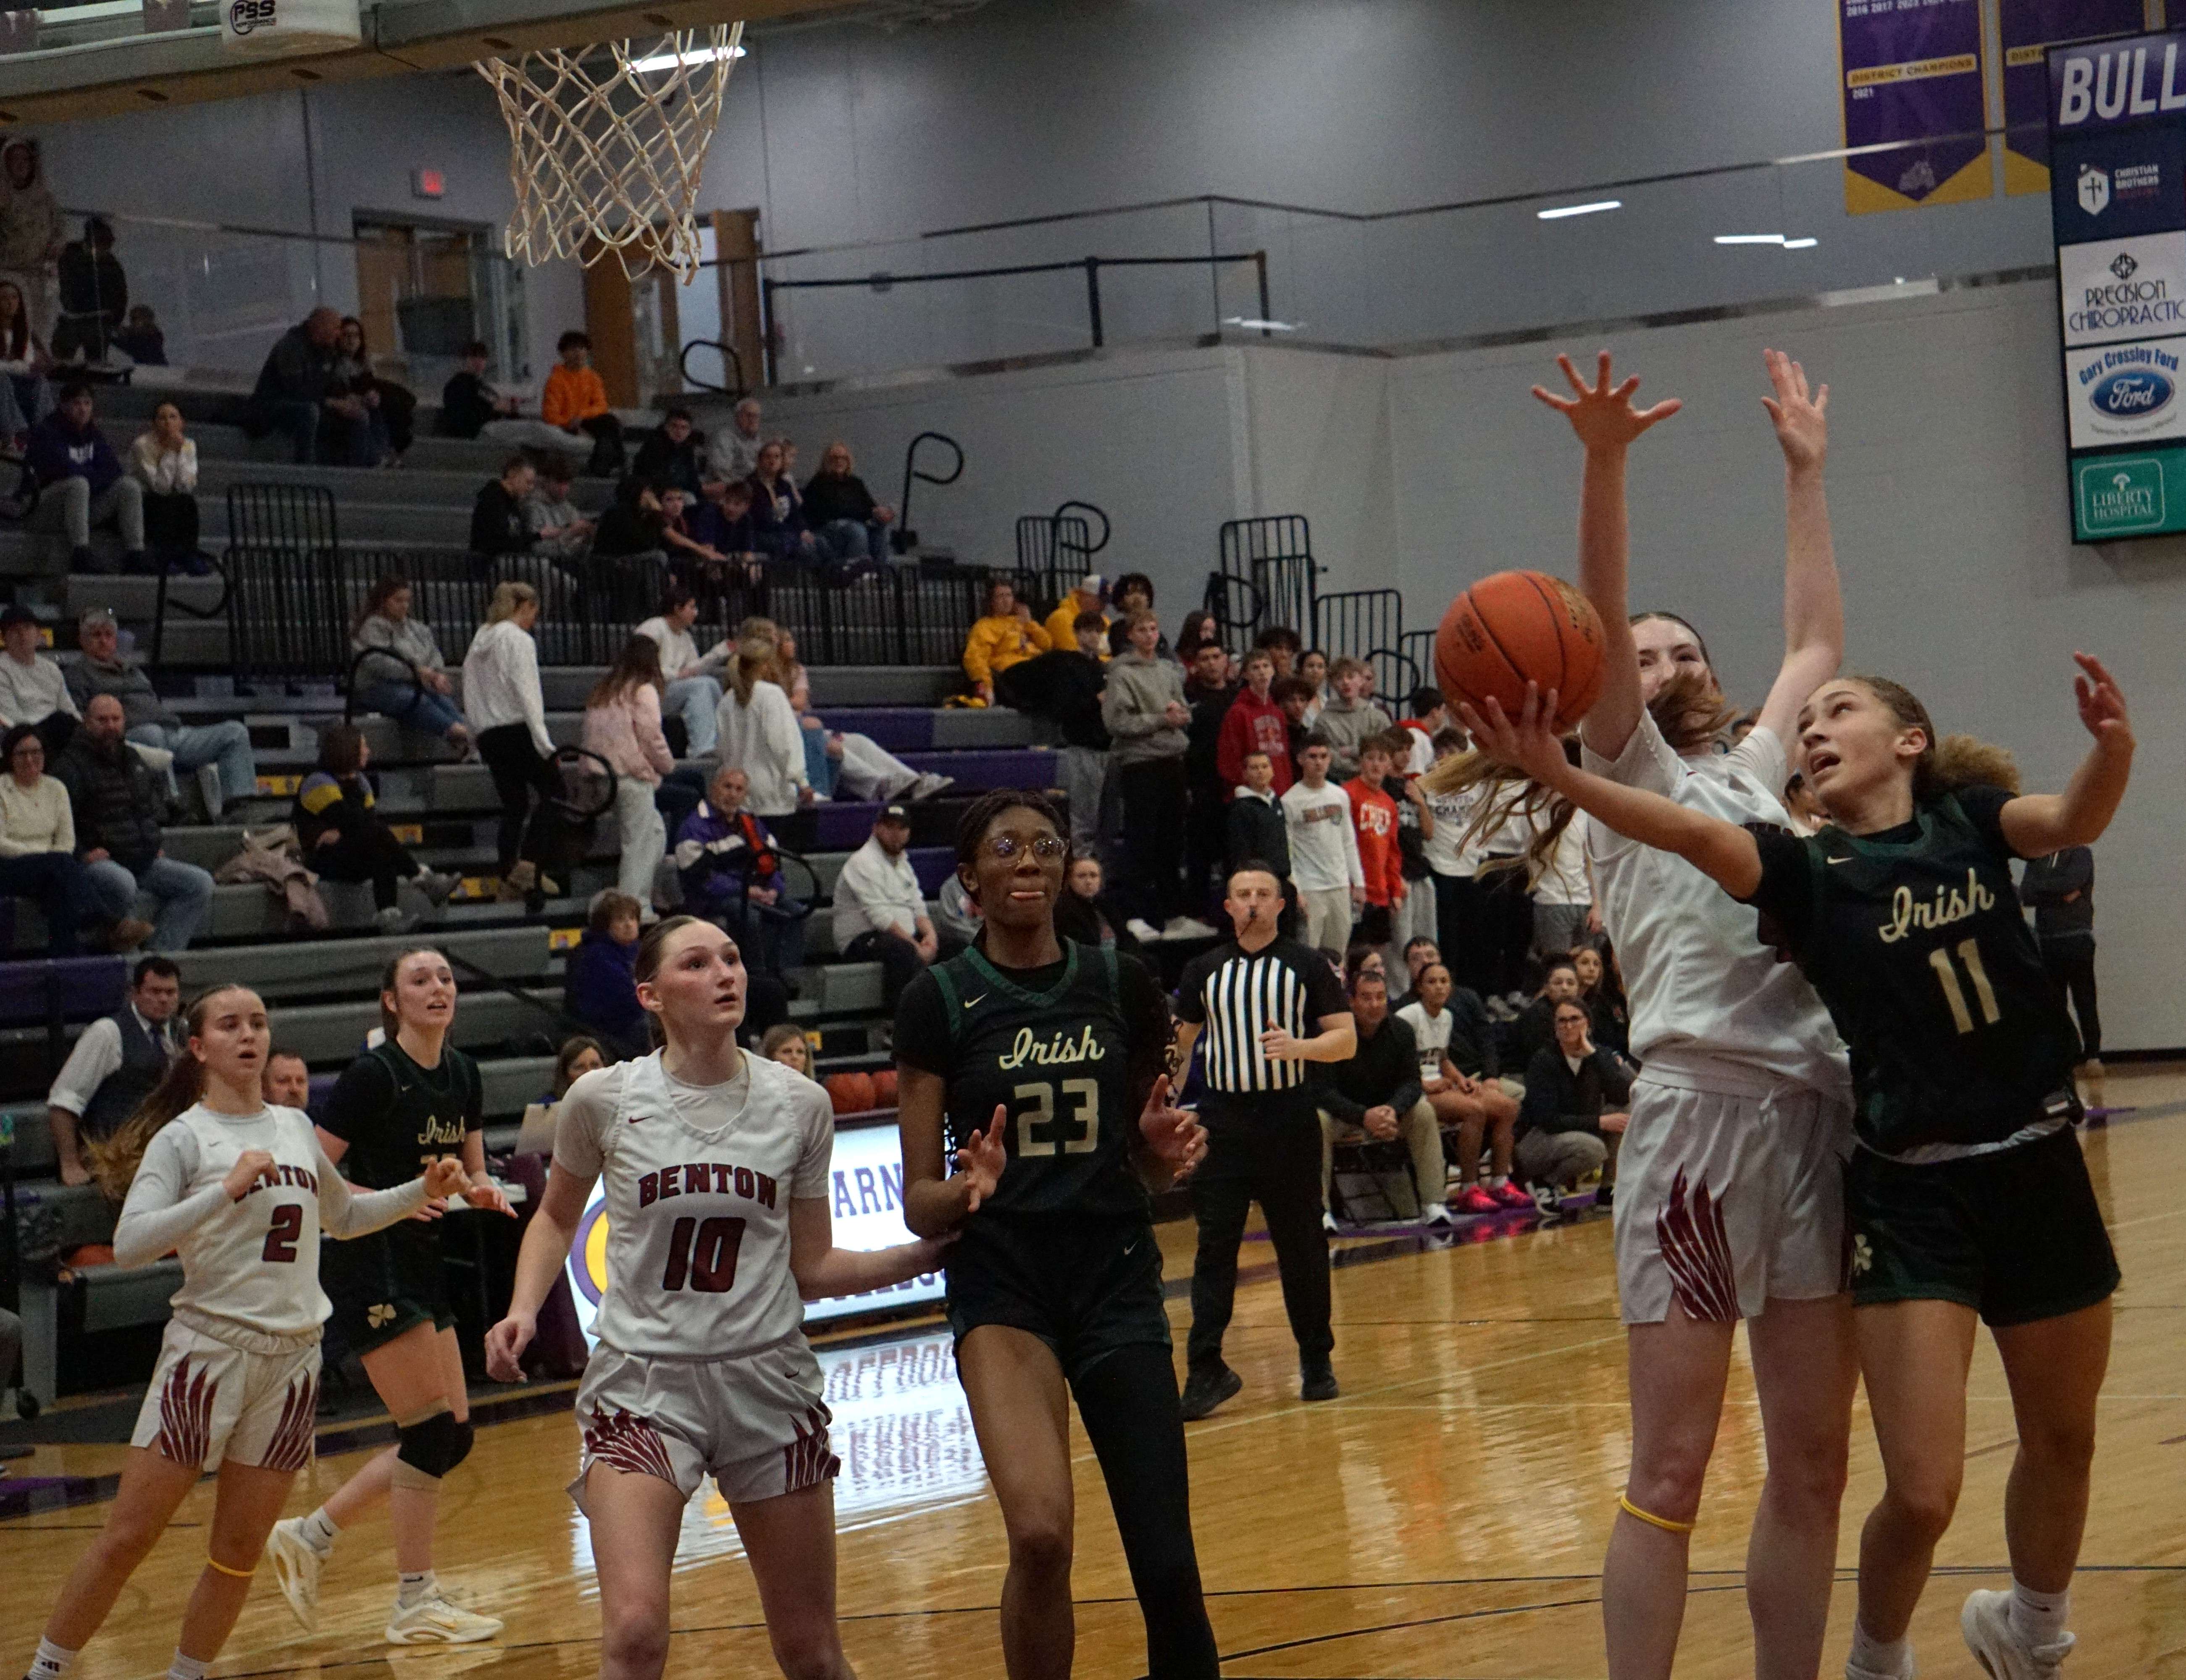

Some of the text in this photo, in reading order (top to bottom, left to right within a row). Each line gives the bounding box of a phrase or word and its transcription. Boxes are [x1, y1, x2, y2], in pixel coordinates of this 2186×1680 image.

[234, 0, 276, 21] PSS
[1852, 58, 1973, 82] DISTRICT CHAMPIONS
[2059, 43, 2186, 125] BULL
[2115, 164, 2159, 178] CHRISTIAN
[2115, 175, 2159, 189] BROTHERS
[2085, 278, 2166, 307] PRECISION
[2079, 346, 2179, 386] Gary Crossley Ford
[2108, 377, 2155, 410] Ford
[2093, 488, 2152, 507] LIBERTY
[2094, 502, 2154, 520] HOSPITAL
[1879, 867, 1995, 943] Irish
[1929, 937, 2001, 1034] 11
[999, 1025, 1105, 1070] Irish
[1014, 1078, 1099, 1157] 23
[638, 1163, 777, 1210] BENTON
[262, 1204, 302, 1263] 2
[662, 1217, 747, 1293] 10
